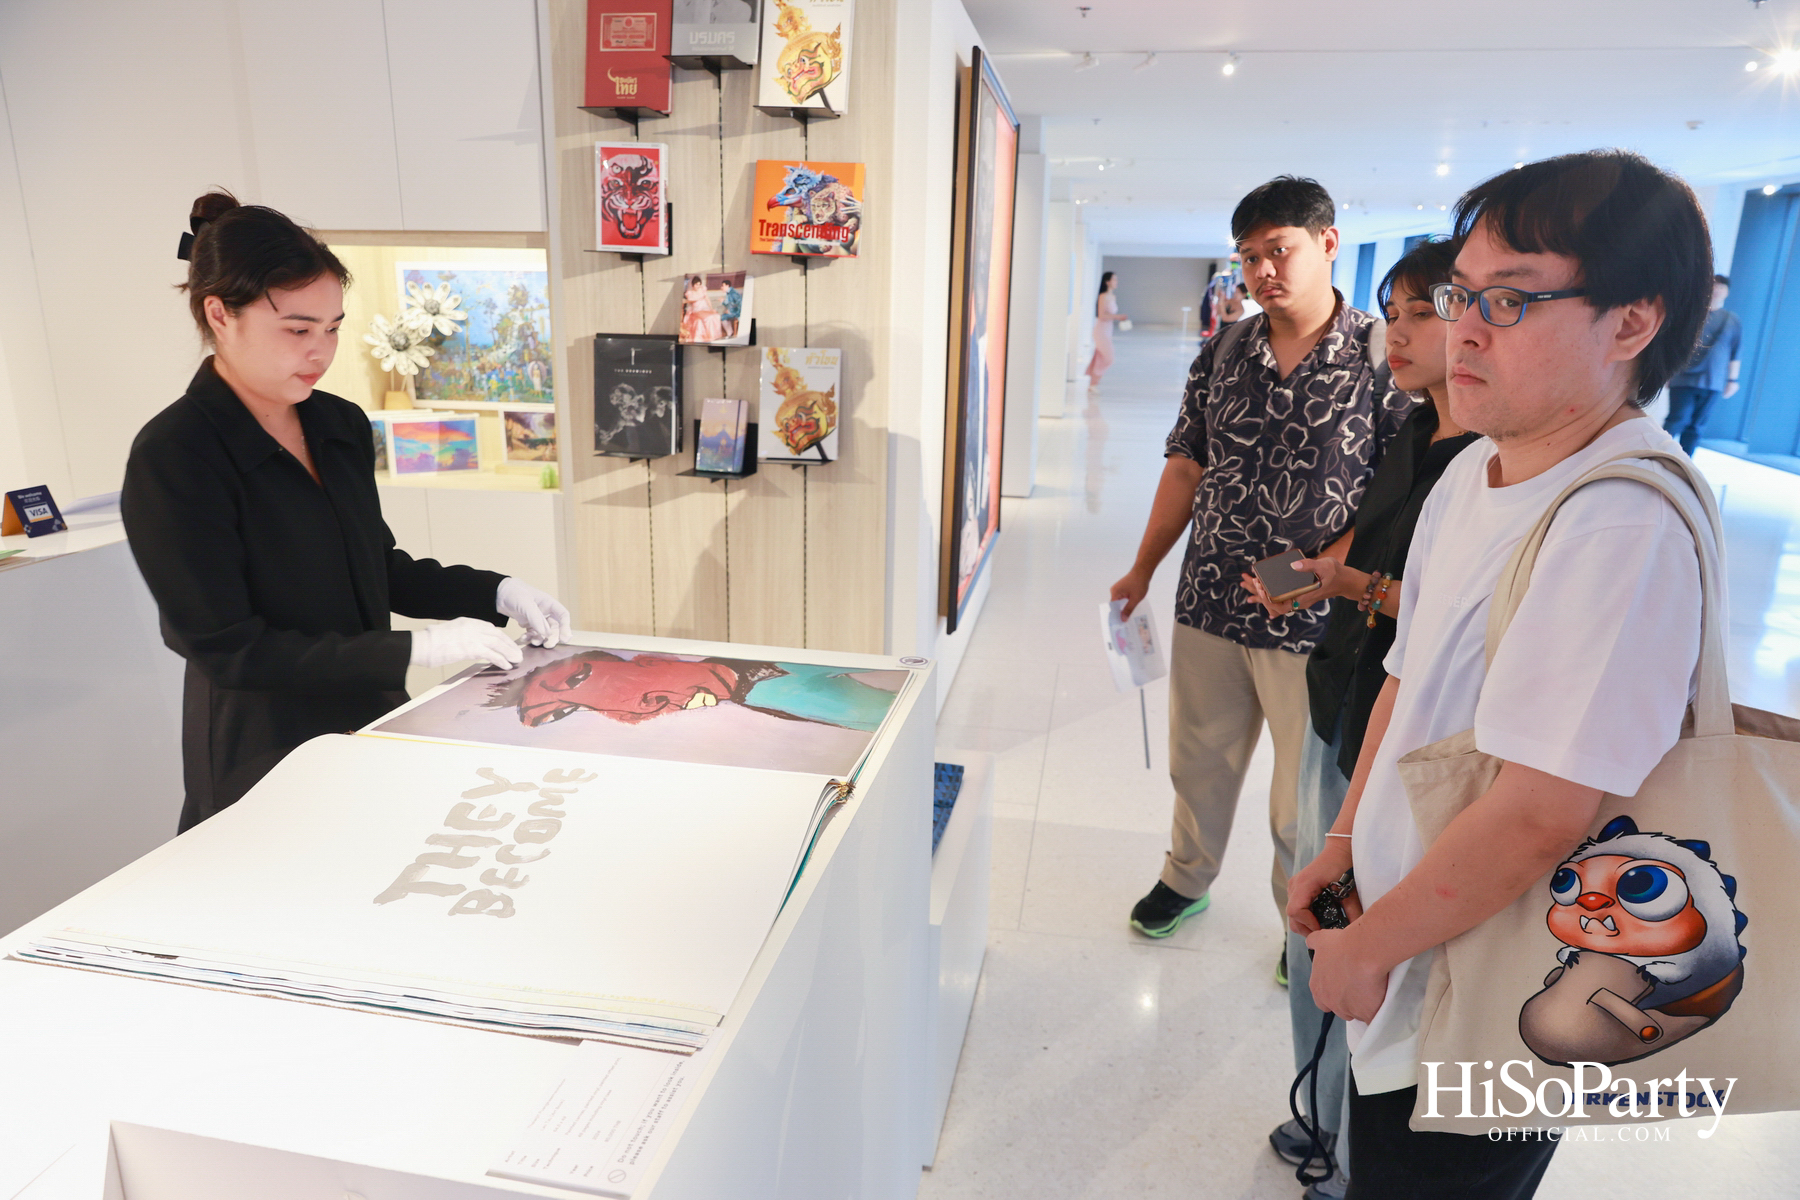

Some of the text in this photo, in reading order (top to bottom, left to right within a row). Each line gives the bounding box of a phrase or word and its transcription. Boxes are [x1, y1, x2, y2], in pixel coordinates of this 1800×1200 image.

[759, 219, 850, 243] Transcending
[29, 507, 48, 516] VISA
[373, 767, 540, 906] THEY
[447, 768, 598, 918] BECOME
[617, 1154, 627, 1163] Do
[624, 1143, 633, 1153] not
[646, 1108, 655, 1118] you
[652, 1094, 663, 1107] want
[663, 1076, 674, 1087] look
[629, 1146, 643, 1165] please
[641, 1135, 649, 1145] ask
[647, 1124, 655, 1134] our
[653, 1109, 664, 1124] staff
[666, 1087, 678, 1102] assist
[675, 1076, 685, 1087] you.
[1562, 1090, 1726, 1109] RKENSTOCK
